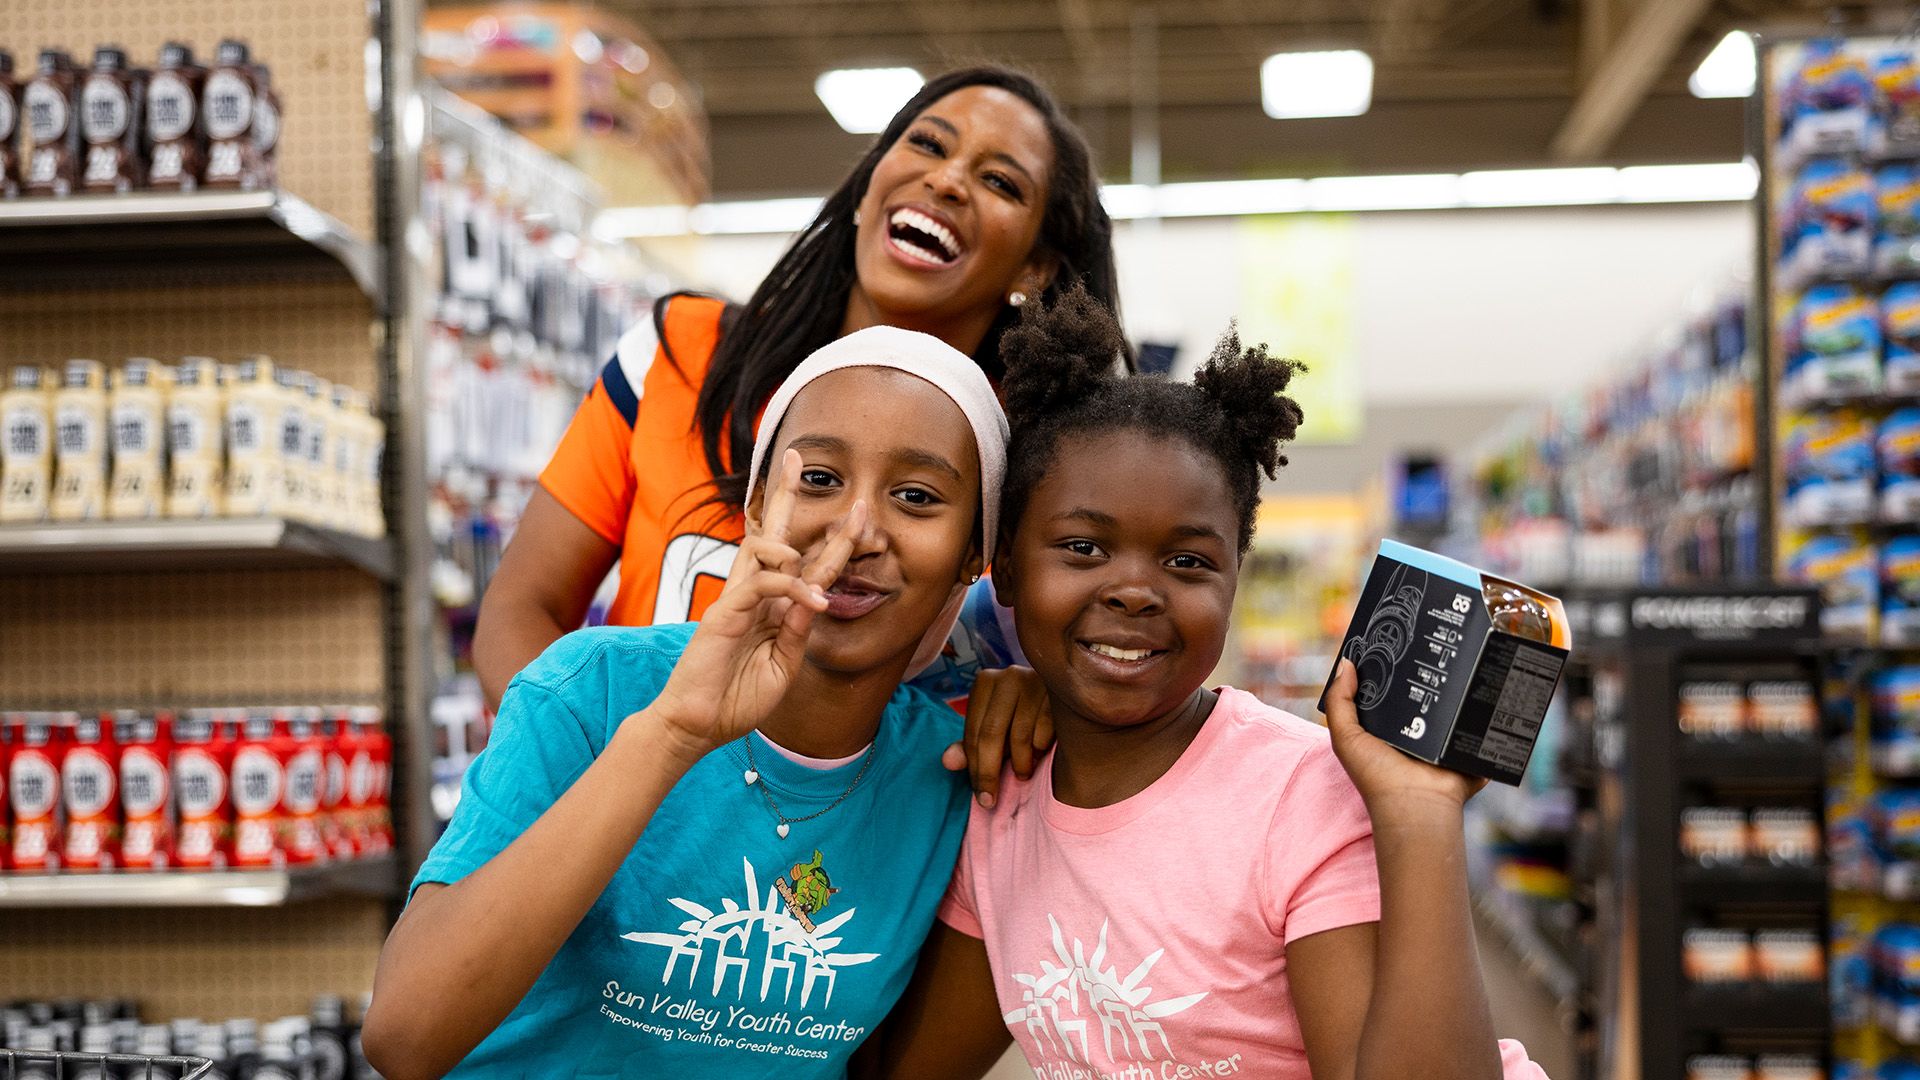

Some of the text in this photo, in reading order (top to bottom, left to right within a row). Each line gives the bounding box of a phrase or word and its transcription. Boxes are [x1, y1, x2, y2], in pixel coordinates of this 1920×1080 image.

[599, 1004, 828, 1059] Empowering Youth for Greater Success
[602, 980, 865, 1041] Sun Valley Youth Center
[1161, 1053, 1241, 1080] Center
